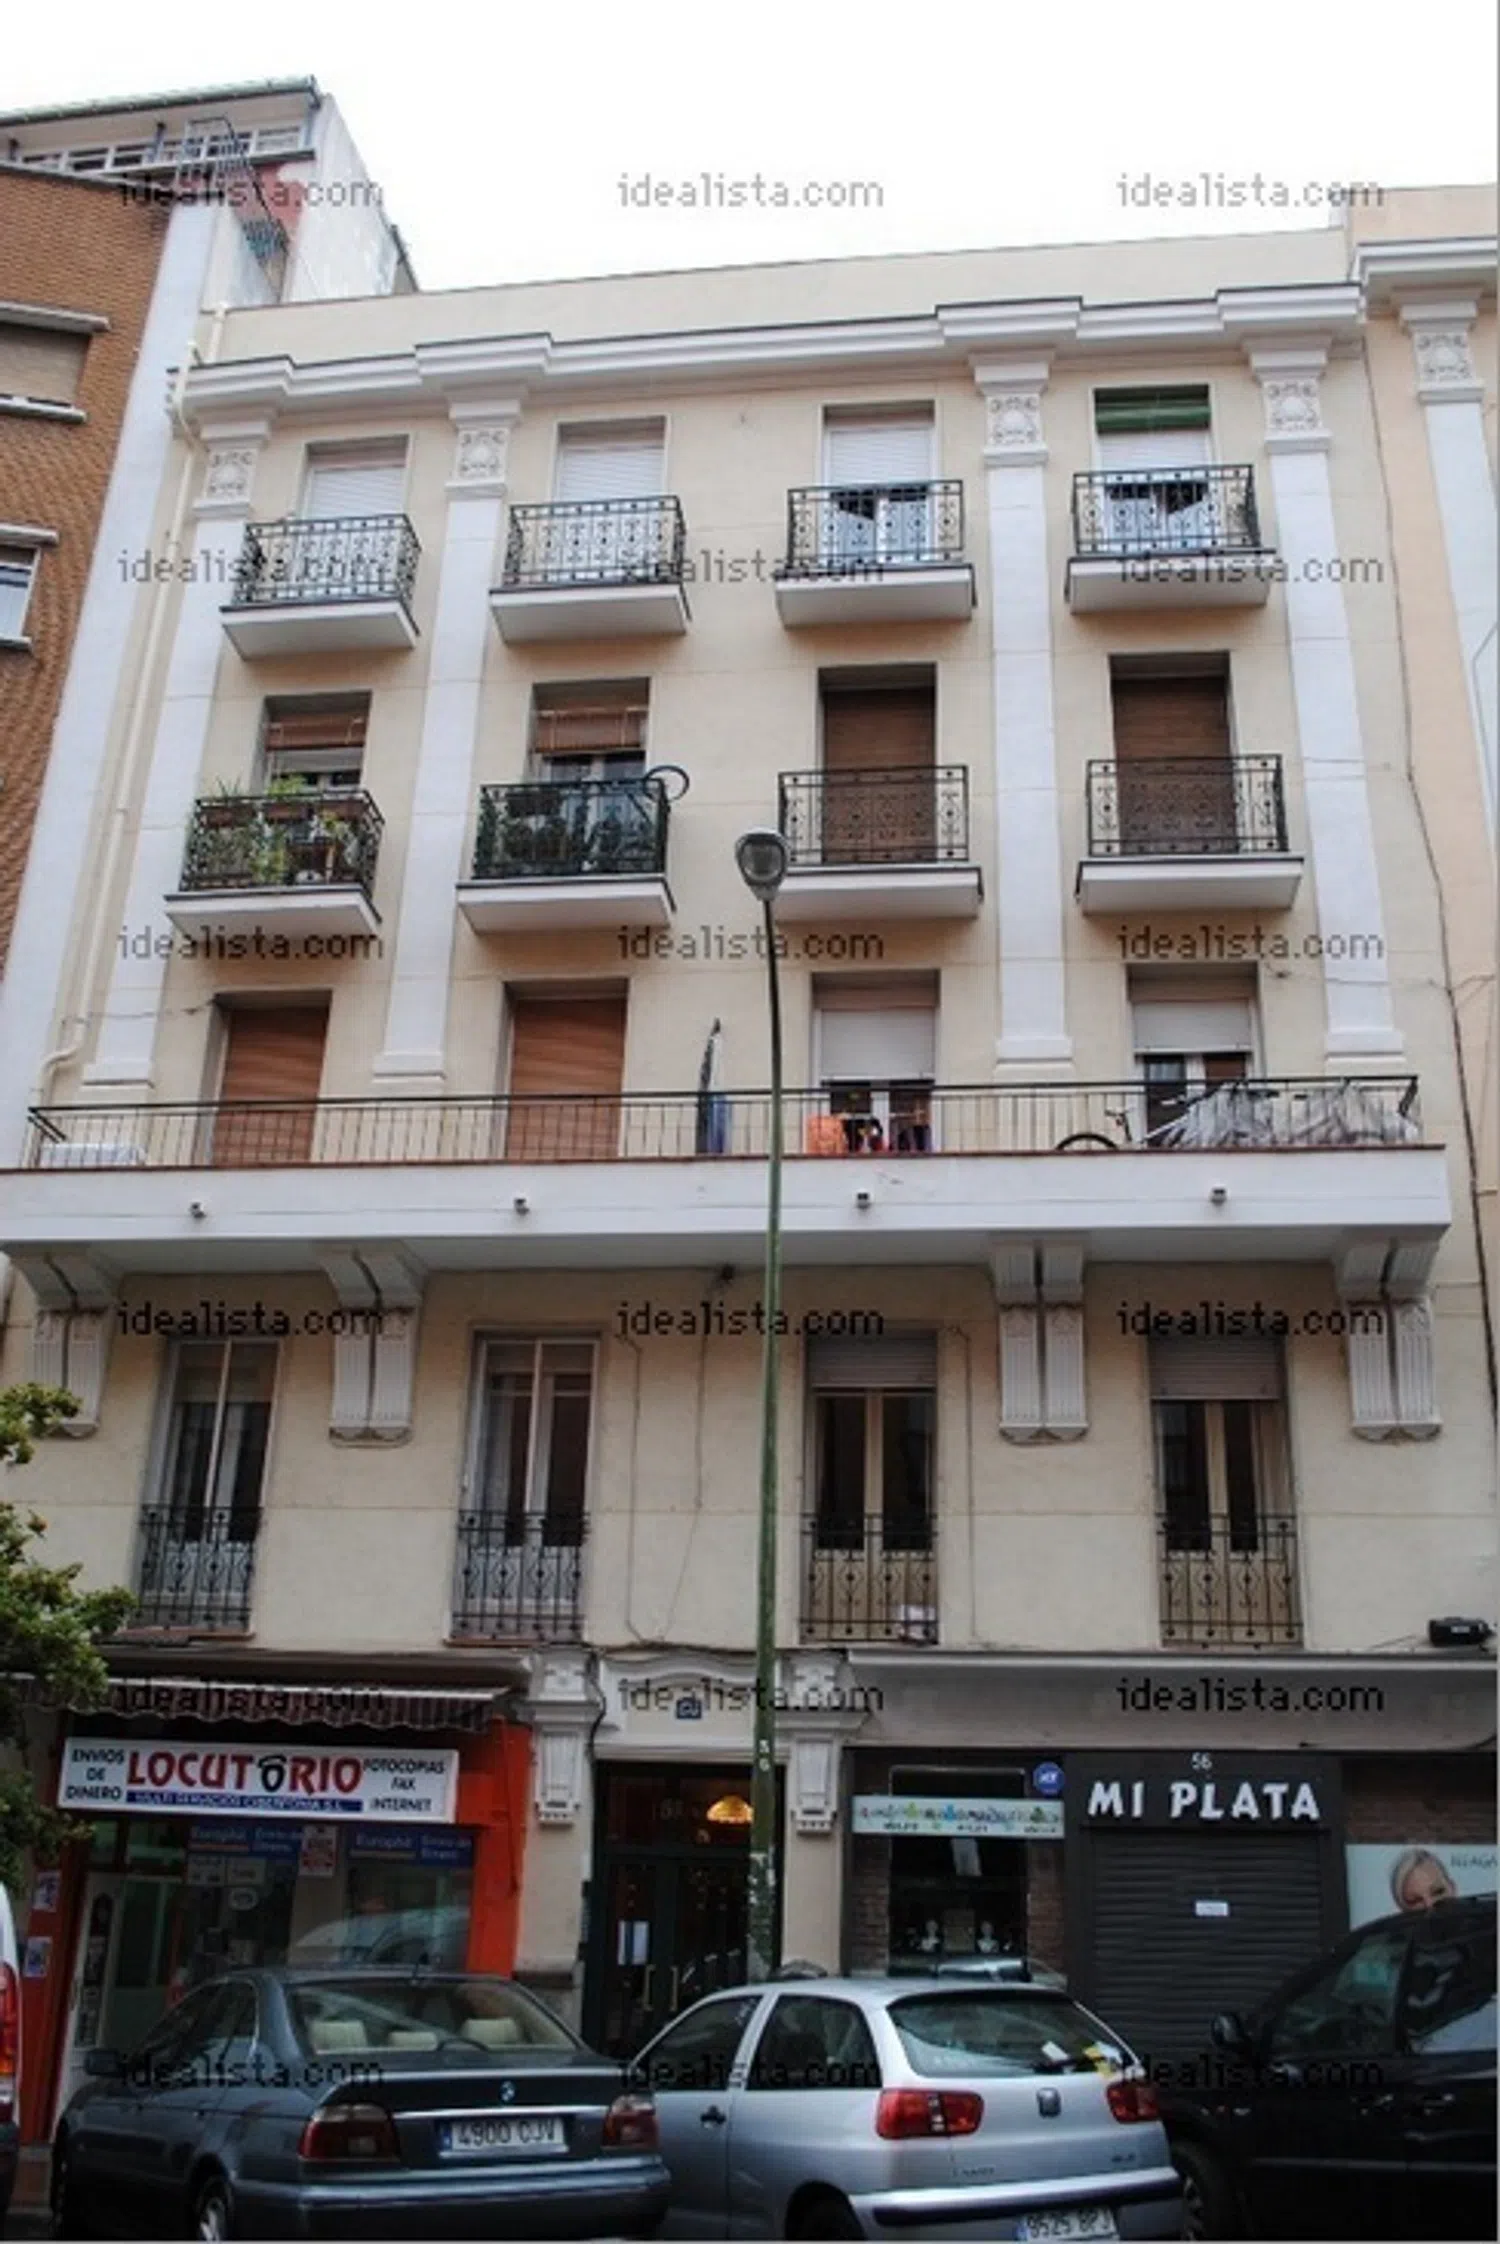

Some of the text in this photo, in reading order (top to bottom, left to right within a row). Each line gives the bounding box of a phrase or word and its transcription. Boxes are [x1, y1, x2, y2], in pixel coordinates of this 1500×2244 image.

[71, 1748, 125, 1764] ENVIOS
[1191, 1752, 1213, 1771] 56
[126, 1750, 363, 1796] LOCUTORIO
[363, 1757, 446, 1774] FOTOCOPIAS
[85, 1767, 107, 1782] DE
[65, 1784, 123, 1801] DINERO
[390, 1777, 417, 1791] FAX
[369, 1798, 433, 1812] INTERNET
[1087, 1780, 1146, 1819] MI
[1168, 1781, 1321, 1820] PLATA
[456, 2120, 513, 2147] 4900
